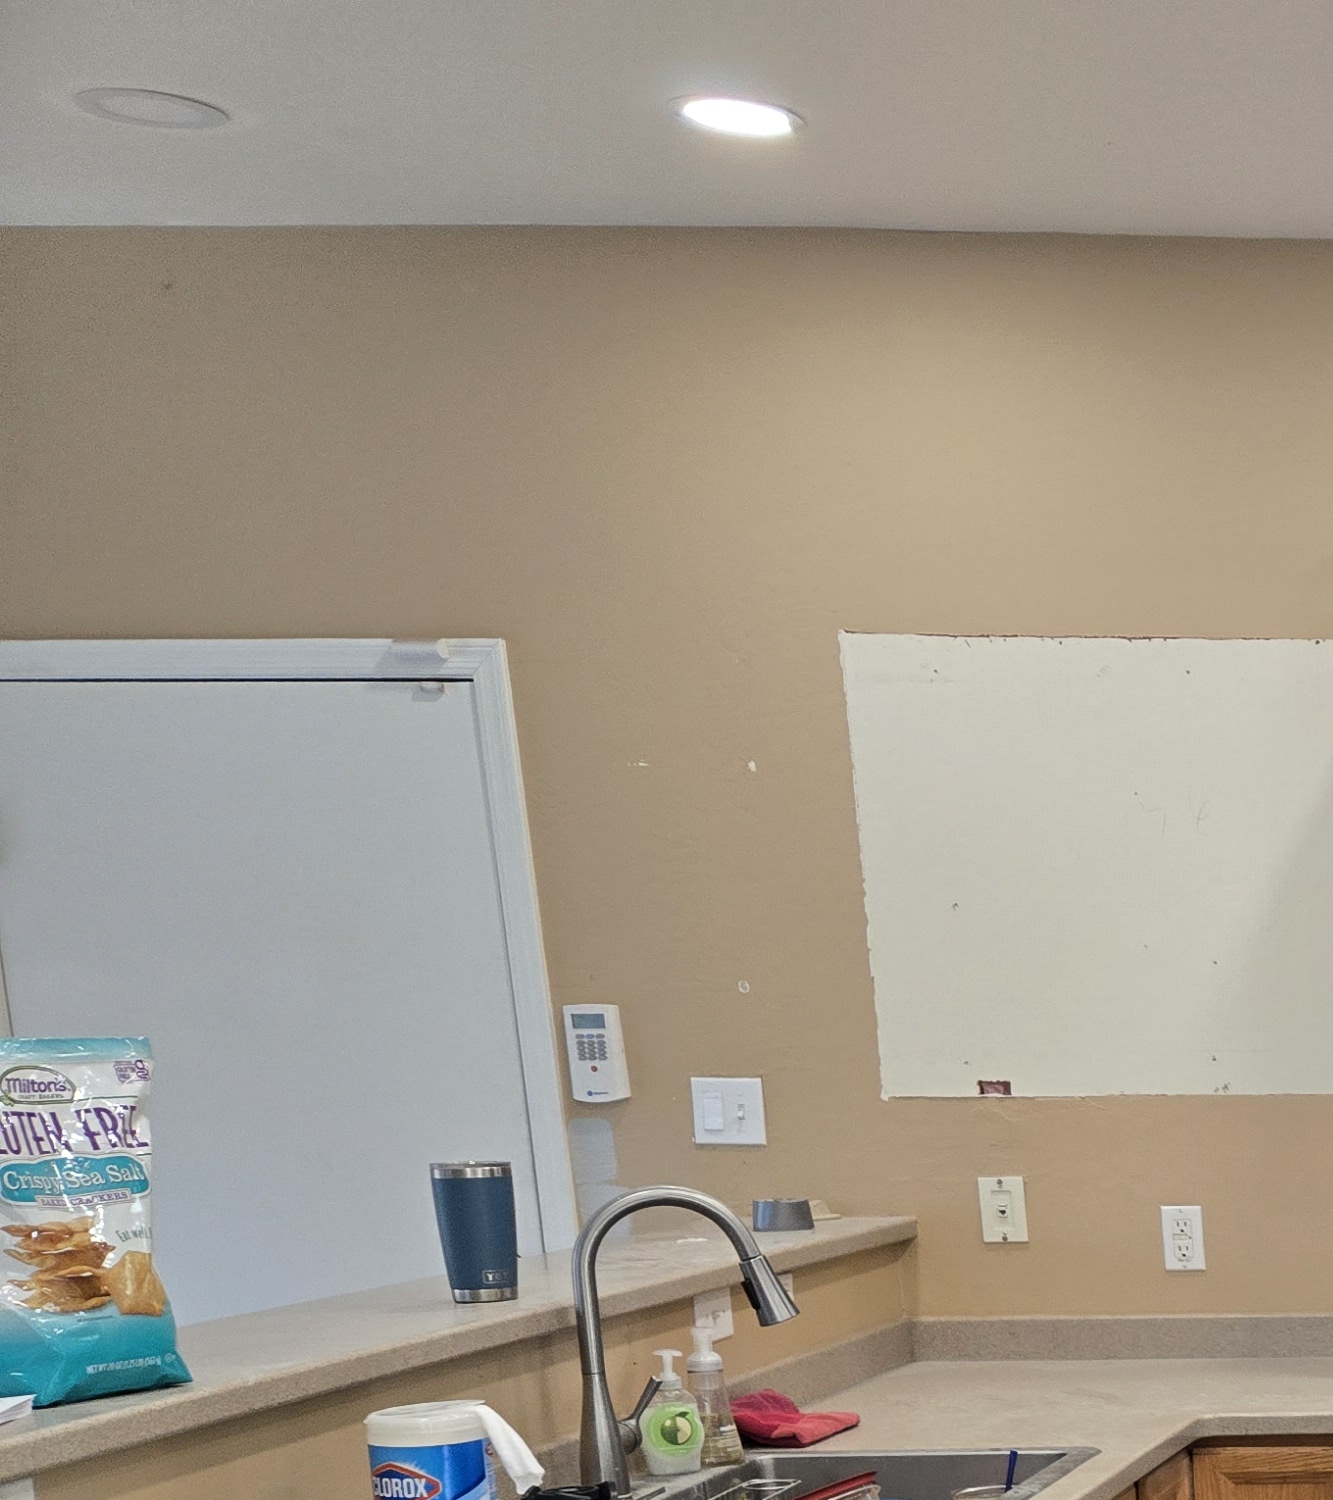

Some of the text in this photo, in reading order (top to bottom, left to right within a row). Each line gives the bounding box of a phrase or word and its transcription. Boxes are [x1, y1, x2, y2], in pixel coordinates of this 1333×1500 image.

[0, 1105, 149, 1155] UTEN FREE
[3, 1163, 145, 1194] Crispy Sea Salt
[70, 1191, 129, 1206] CRACKERS
[373, 1476, 428, 1498] CLOROX
